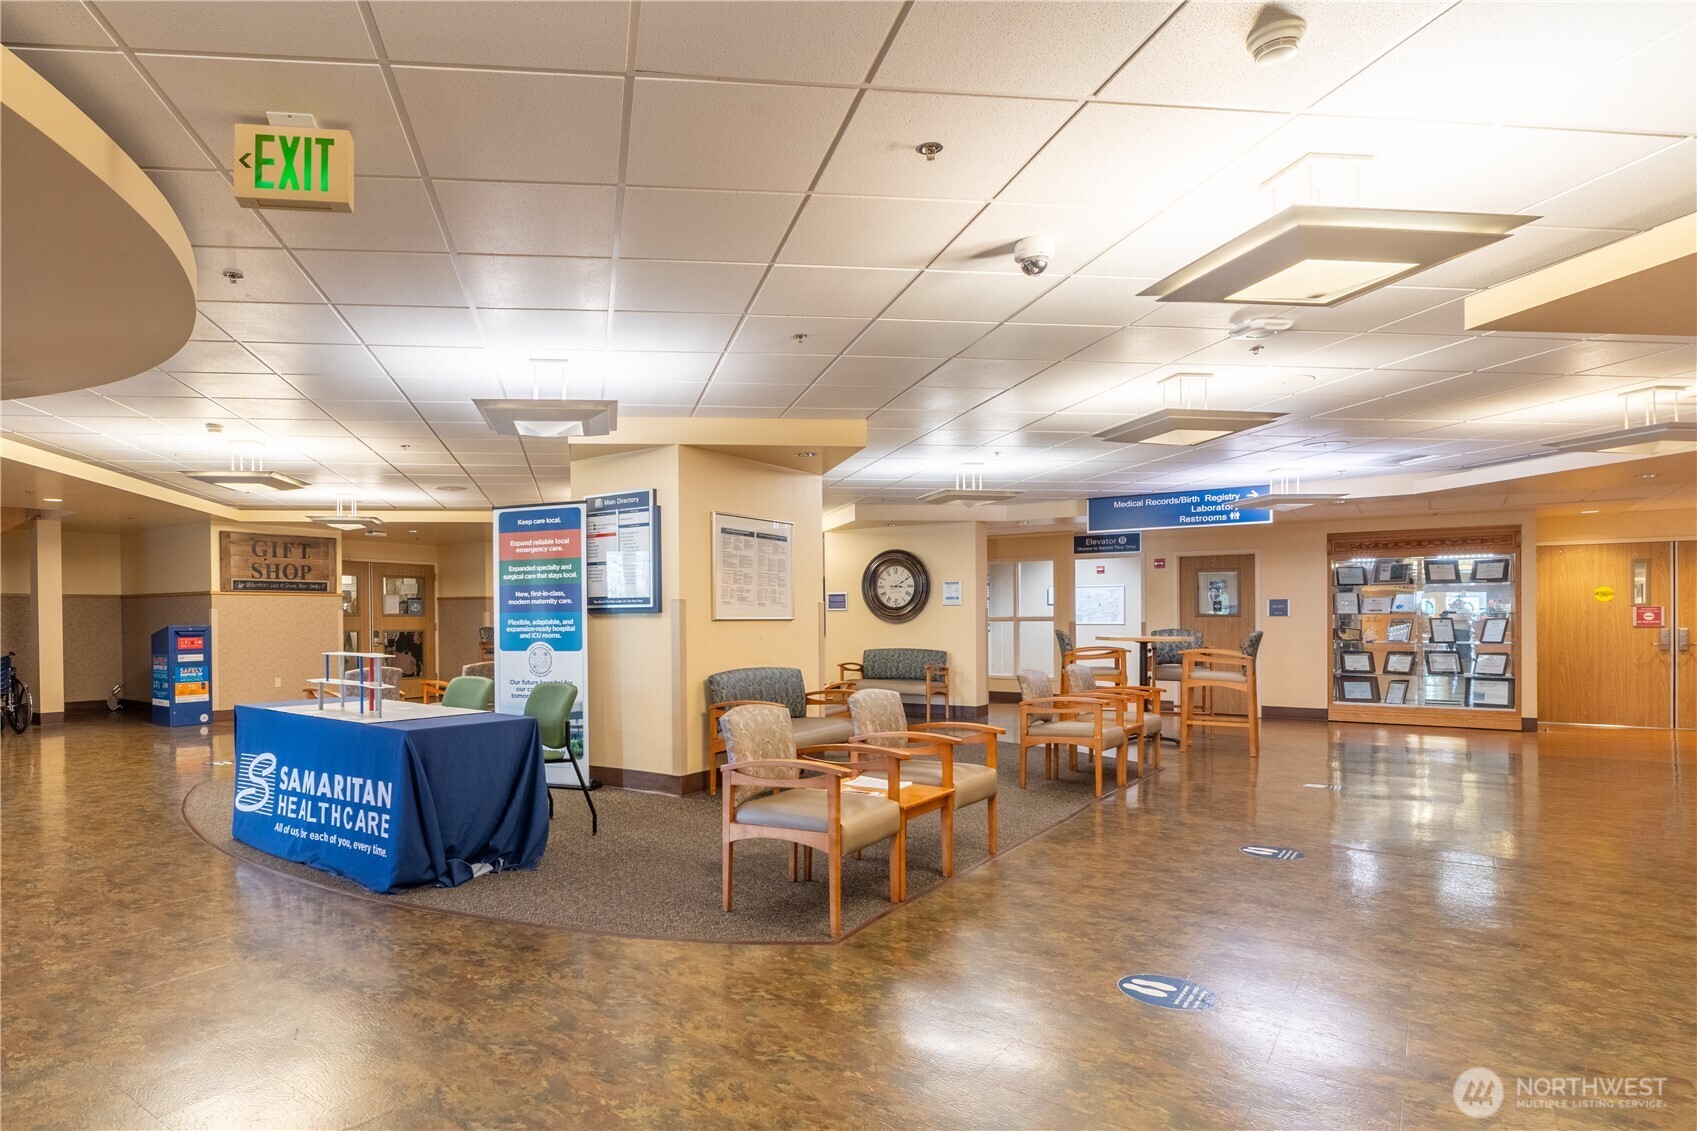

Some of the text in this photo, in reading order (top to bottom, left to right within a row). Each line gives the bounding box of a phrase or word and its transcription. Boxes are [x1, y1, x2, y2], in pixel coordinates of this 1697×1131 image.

[255, 134, 334, 192] EXIT
[617, 496, 639, 504] Directory
[1114, 493, 1240, 508] Medical Records/Birth Registry
[1191, 503, 1238, 513] Laborator
[1180, 512, 1227, 523] Restrooms
[251, 540, 311, 560] GIFT
[251, 562, 312, 580] SHOP
[279, 766, 392, 809] SAMARITAN
[277, 794, 390, 839] HEALTHCARE
[274, 822, 283, 833] All
[283, 826, 291, 834] of
[291, 827, 299, 838] us,
[309, 831, 329, 842] each
[330, 834, 337, 844] of
[338, 838, 351, 850] you,
[353, 841, 372, 854] every
[372, 845, 387, 858] time.
